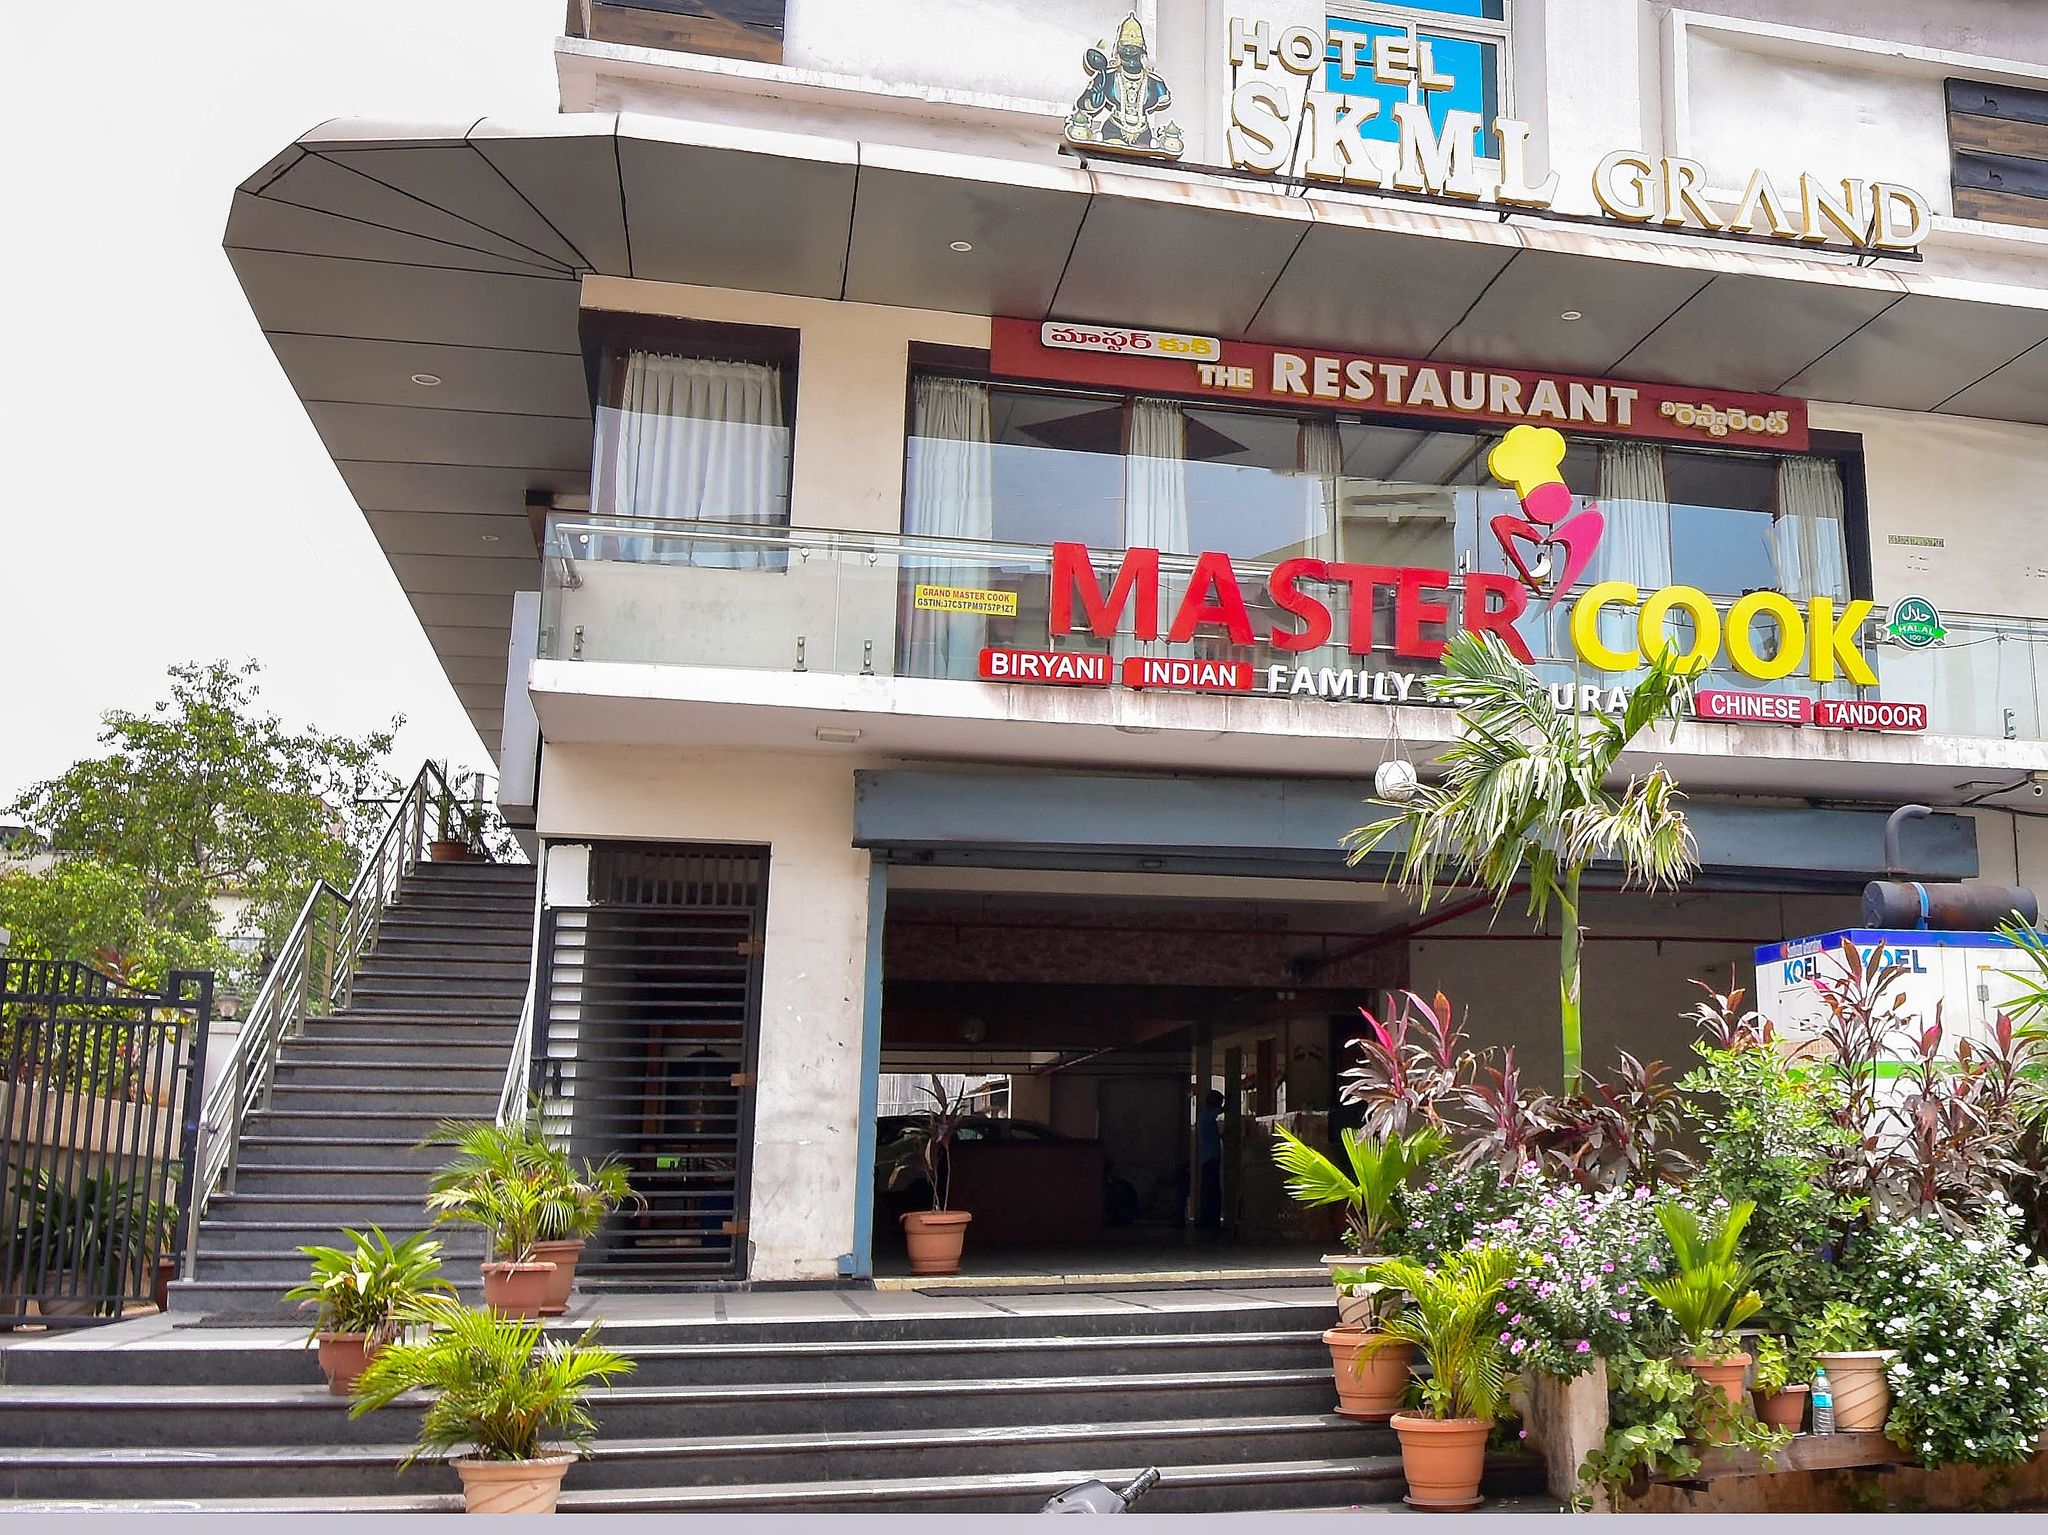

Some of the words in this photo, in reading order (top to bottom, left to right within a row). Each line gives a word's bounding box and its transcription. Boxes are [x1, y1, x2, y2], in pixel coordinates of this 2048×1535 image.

[1229, 17, 1454, 91] HOTEL
[1227, 81, 1560, 208] SKML
[1592, 150, 1932, 250] GRAND
[1052, 328, 1152, 351] మాస్టర్
[1198, 364, 1254, 390] THE
[1272, 352, 1639, 426] RESTAURANT
[922, 588, 951, 598] GRAND
[952, 590, 985, 600] MASTER
[987, 593, 1010, 602] COOK
[1050, 541, 1535, 664] MASTER
[1570, 581, 1879, 686] COOK
[1902, 604, 1931, 622] حلال
[1898, 624, 1935, 635] HALAL
[990, 652, 1104, 680] BIRYANI
[1144, 661, 1237, 687] INDIAN
[1267, 664, 1415, 702] FAMILY
[1711, 693, 1802, 720] CHINESE
[1824, 704, 1924, 727] TANDOOR
[1783, 956, 1821, 986] KOEL
